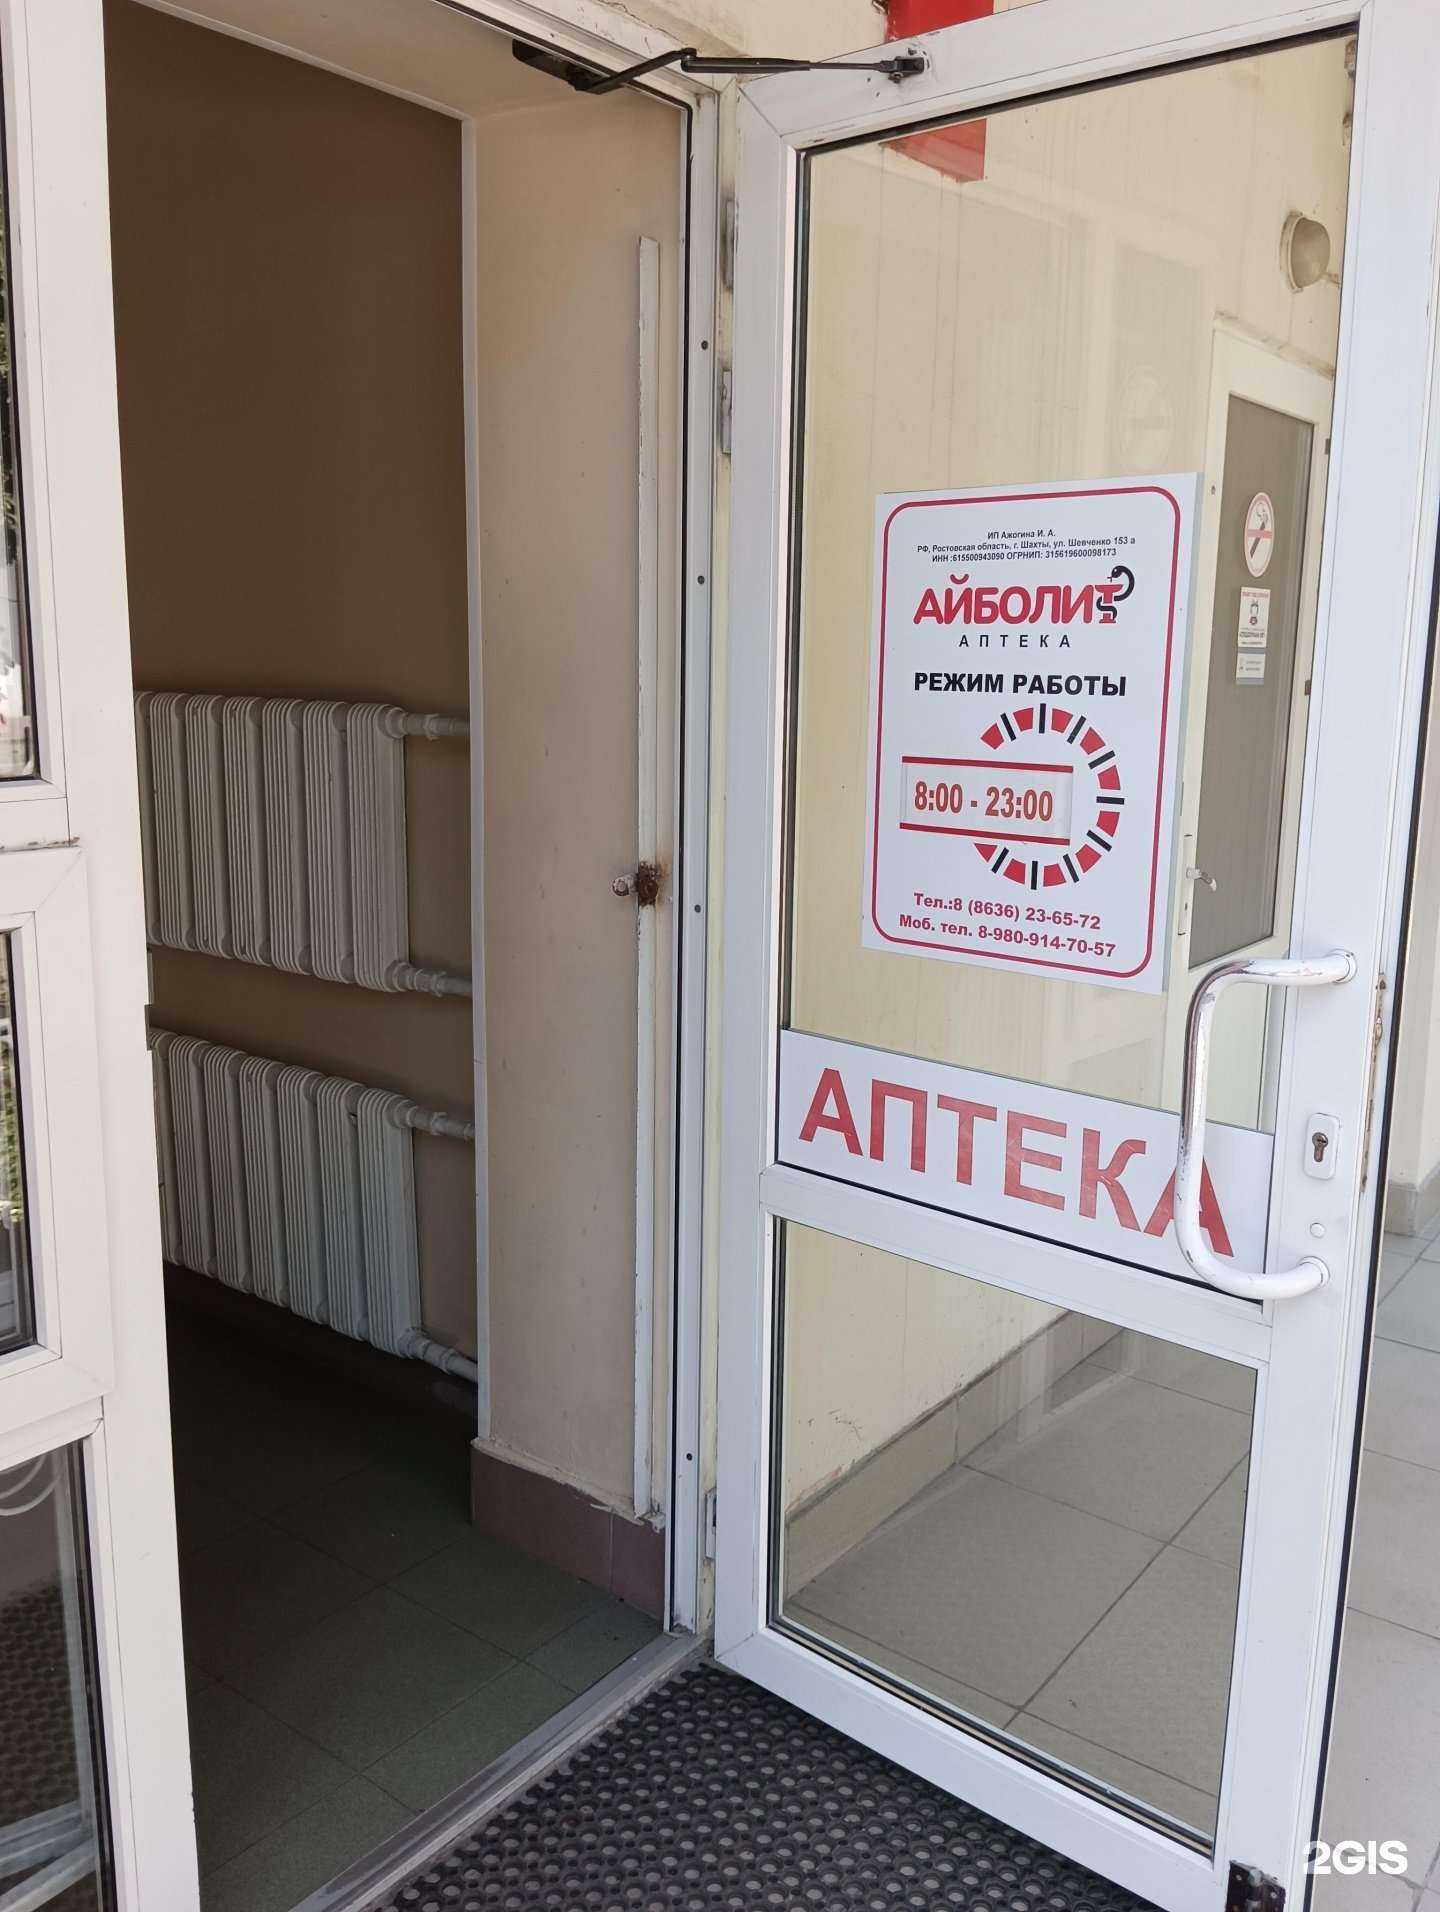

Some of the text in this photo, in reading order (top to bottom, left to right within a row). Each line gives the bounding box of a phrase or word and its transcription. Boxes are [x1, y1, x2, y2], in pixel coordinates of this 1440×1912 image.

[917, 545, 931, 553] РФ,
[932, 544, 976, 553] Ростовская
[977, 542, 1012, 550] область,
[1020, 540, 1052, 549] Шахты,
[1053, 541, 1066, 549] ул.
[1068, 538, 1111, 547] Шевченко
[1114, 536, 1128, 545] 153
[987, 529, 1056, 540] ИП Ажогина И. А.
[932, 554, 949, 562] ИНН
[1006, 550, 1043, 560] ОГРНИП:
[913, 573, 1124, 625] АЙБОЛИТ
[958, 634, 1071, 648] АПТЕКА
[914, 672, 1127, 697] РЕЖИМ РАБОТЫ
[914, 781, 963, 814] 8:00
[985, 786, 1053, 822] 23:00
[914, 892, 1101, 930] Тел.:8 (8636) 23-65-72
[899, 914, 1116, 957] Моб. тел. 8-980-914-70-57
